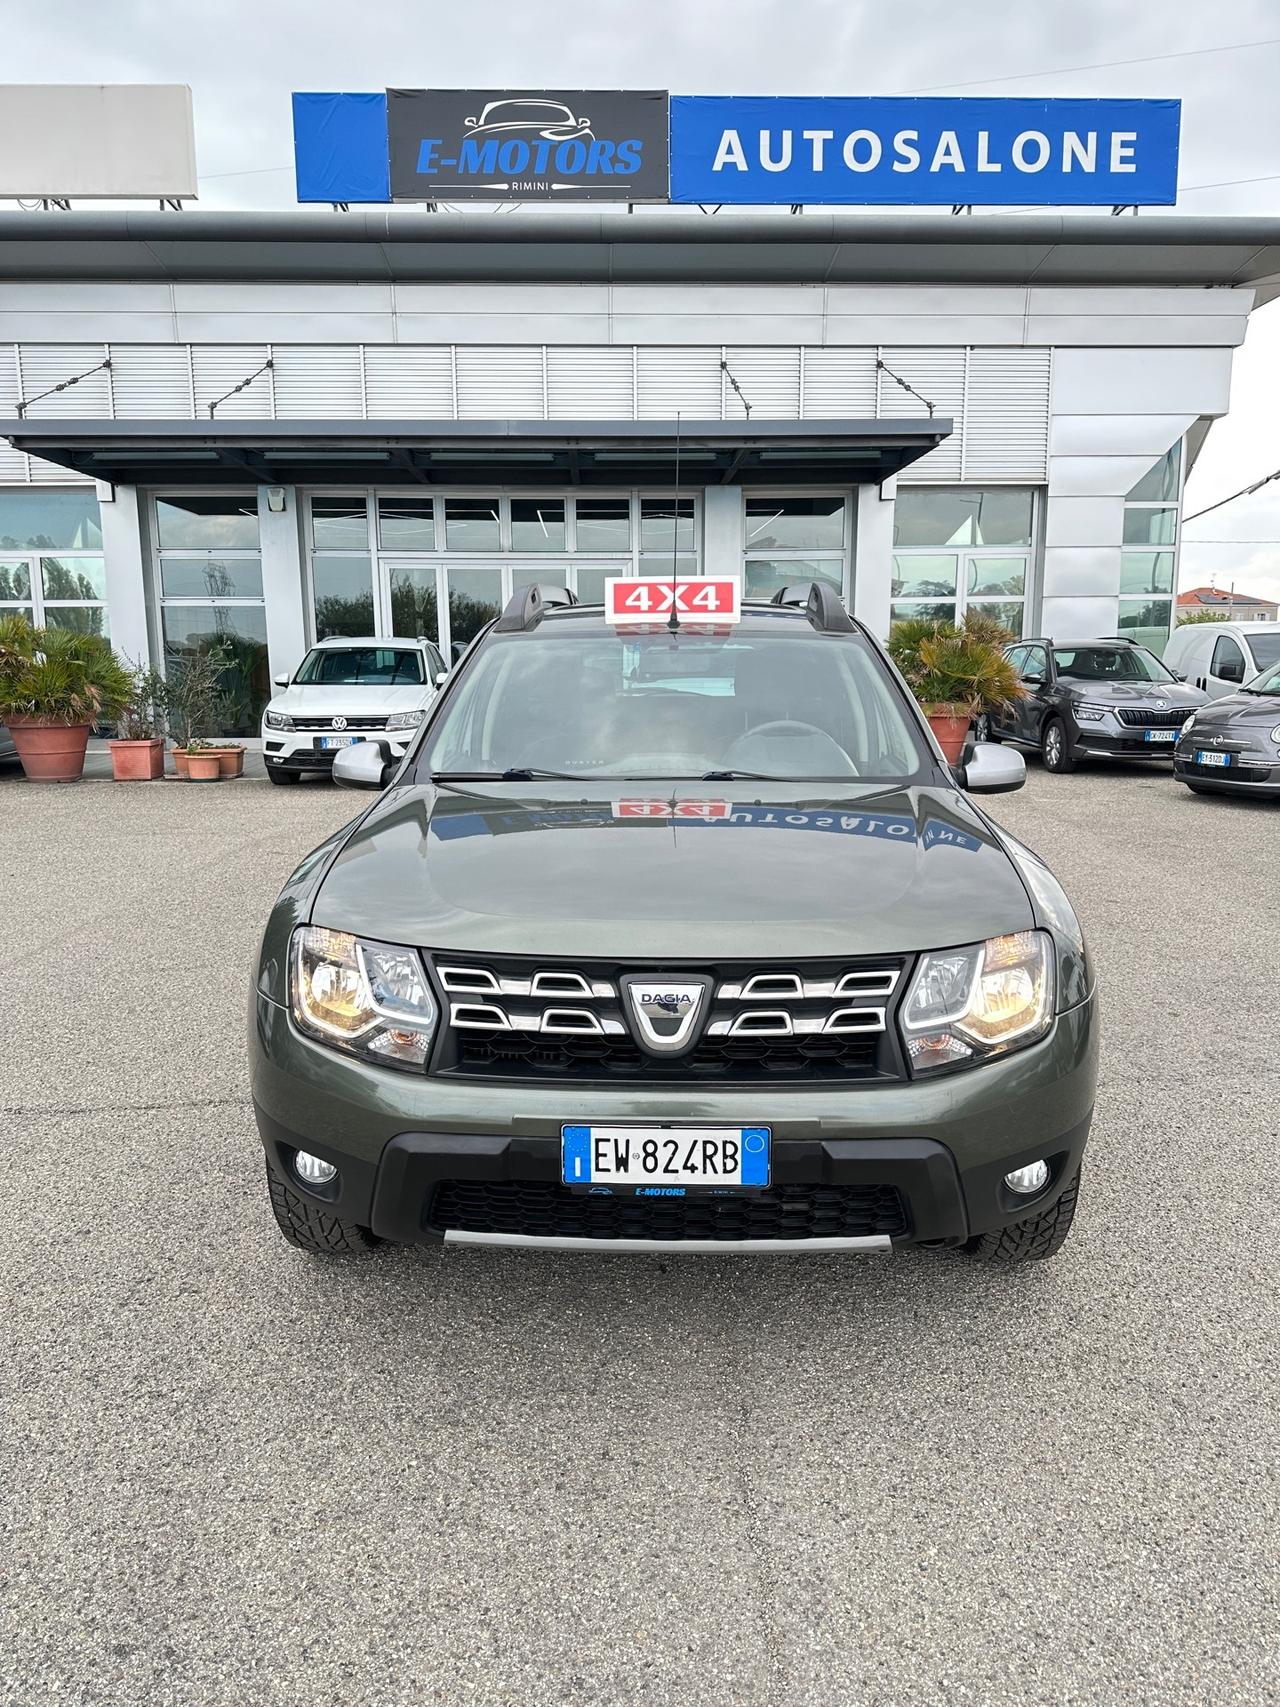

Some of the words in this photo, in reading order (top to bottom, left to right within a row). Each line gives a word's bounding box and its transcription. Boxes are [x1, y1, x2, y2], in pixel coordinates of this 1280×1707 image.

[416, 138, 643, 175] E-MOTORS
[711, 128, 1138, 174] AUTOSALONE
[512, 181, 549, 191] RIMINI
[624, 584, 721, 612] 4X4
[641, 1139, 739, 1175] 824RB
[635, 1187, 686, 1197] E-MOTORS
